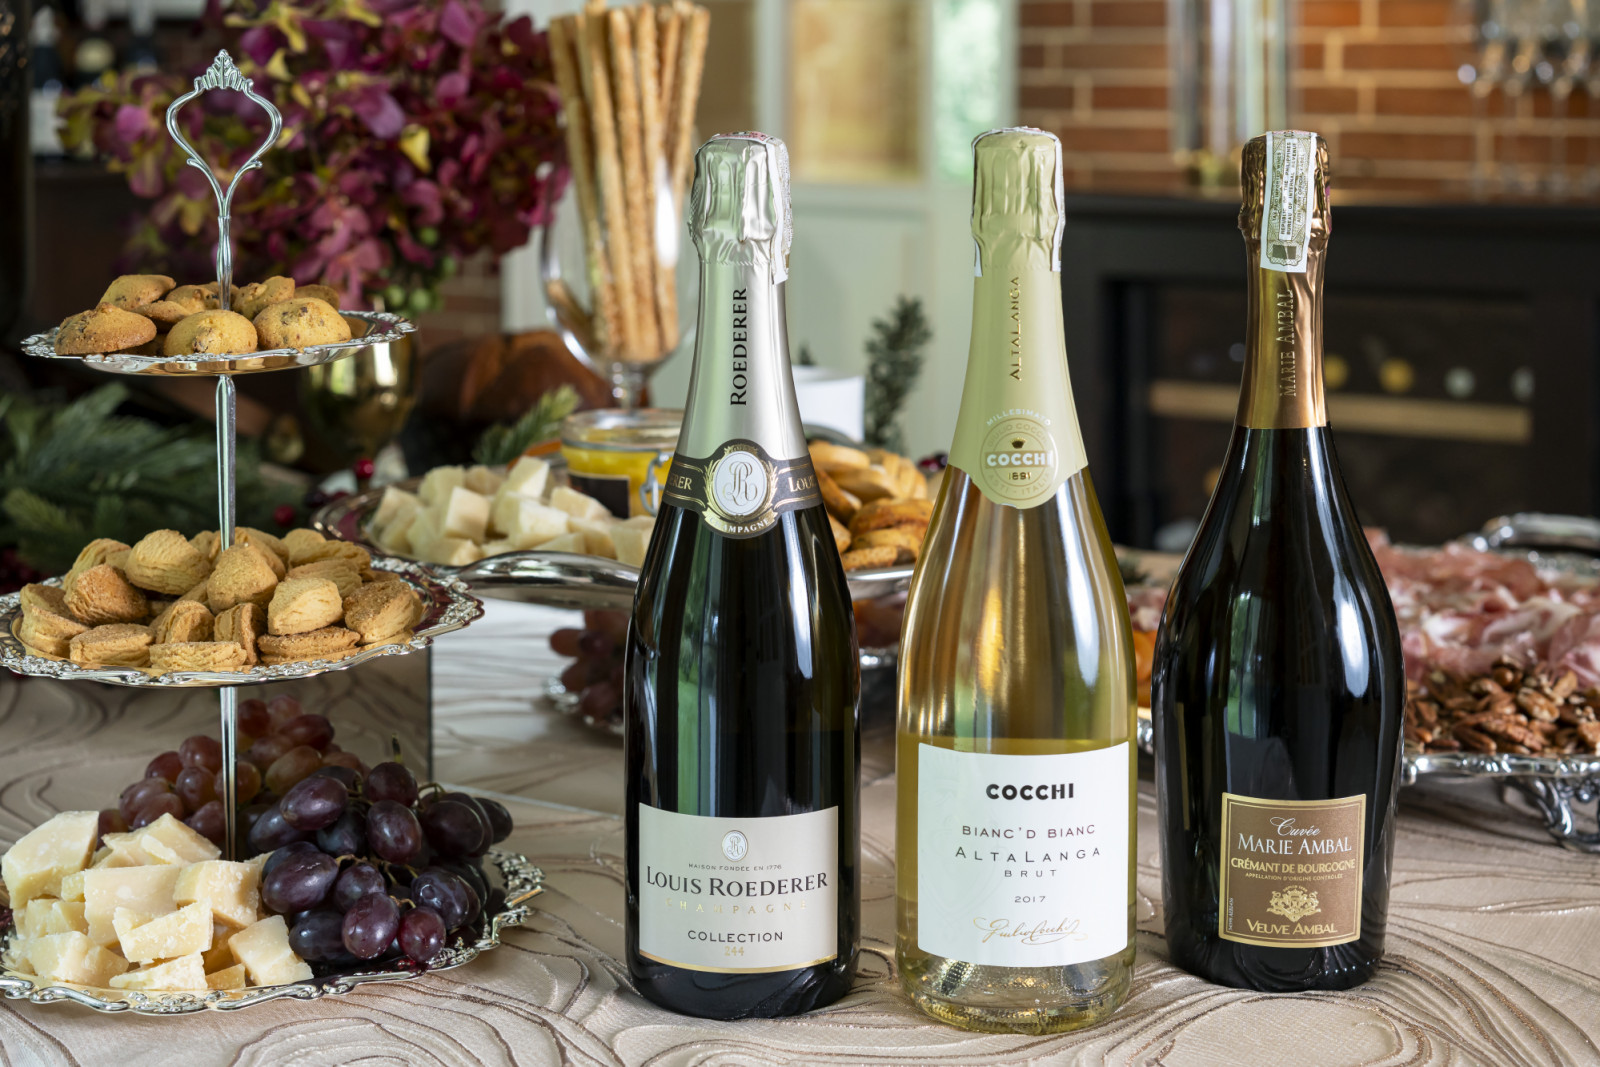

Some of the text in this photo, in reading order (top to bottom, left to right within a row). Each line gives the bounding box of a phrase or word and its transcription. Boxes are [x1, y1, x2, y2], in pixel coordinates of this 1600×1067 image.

[1010, 276, 1022, 381] ALTALANGA
[730, 288, 747, 406] ROEDERER
[1276, 289, 1296, 397] MARIE AMBAL
[986, 408, 1051, 426] MILLESIMATO
[986, 452, 1054, 467] COCCHI
[1008, 471, 1032, 481] 1891
[986, 783, 1074, 800] COCCHI
[1047, 824, 1096, 839] BIANC
[1270, 816, 1321, 837] Cuvée
[1238, 833, 1352, 855] MARIE AMBAL
[955, 846, 1100, 863] ALTALANGA
[1004, 869, 1057, 878] BRUT
[1231, 857, 1356, 874] CRÉMANT DE BOURGOGNE
[646, 865, 828, 898] LOUIS ROEDERER
[1245, 872, 1281, 881] APPELLATION
[665, 898, 807, 914] CHAMPAGNE
[1014, 895, 1046, 903] 2017
[1246, 919, 1338, 935] VEUVE AMBAL
[687, 930, 783, 943] COLLECTION
[724, 946, 745, 957] 244
